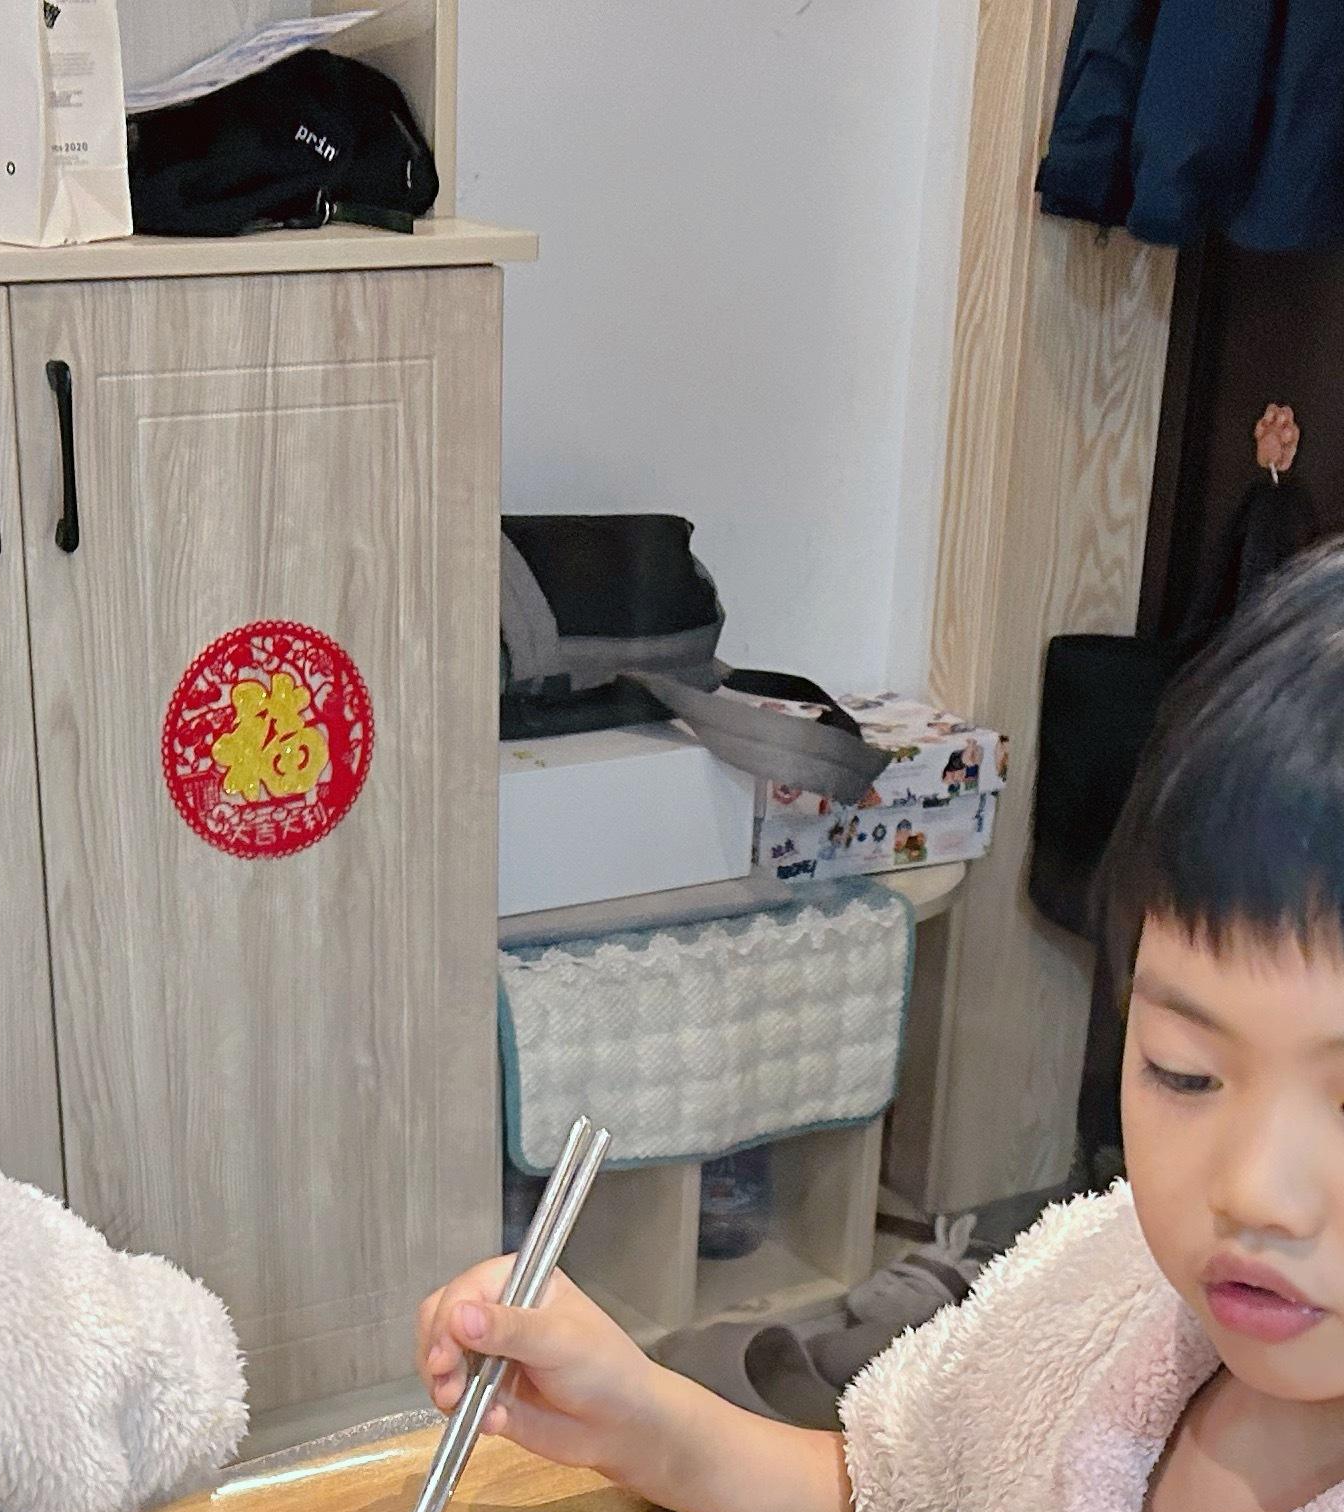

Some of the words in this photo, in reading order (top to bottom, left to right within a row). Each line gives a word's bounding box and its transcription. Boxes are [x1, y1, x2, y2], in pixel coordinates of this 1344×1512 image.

[294, 124, 340, 162] prin
[212, 673, 330, 802] 福
[230, 801, 328, 846] 大吉大利
